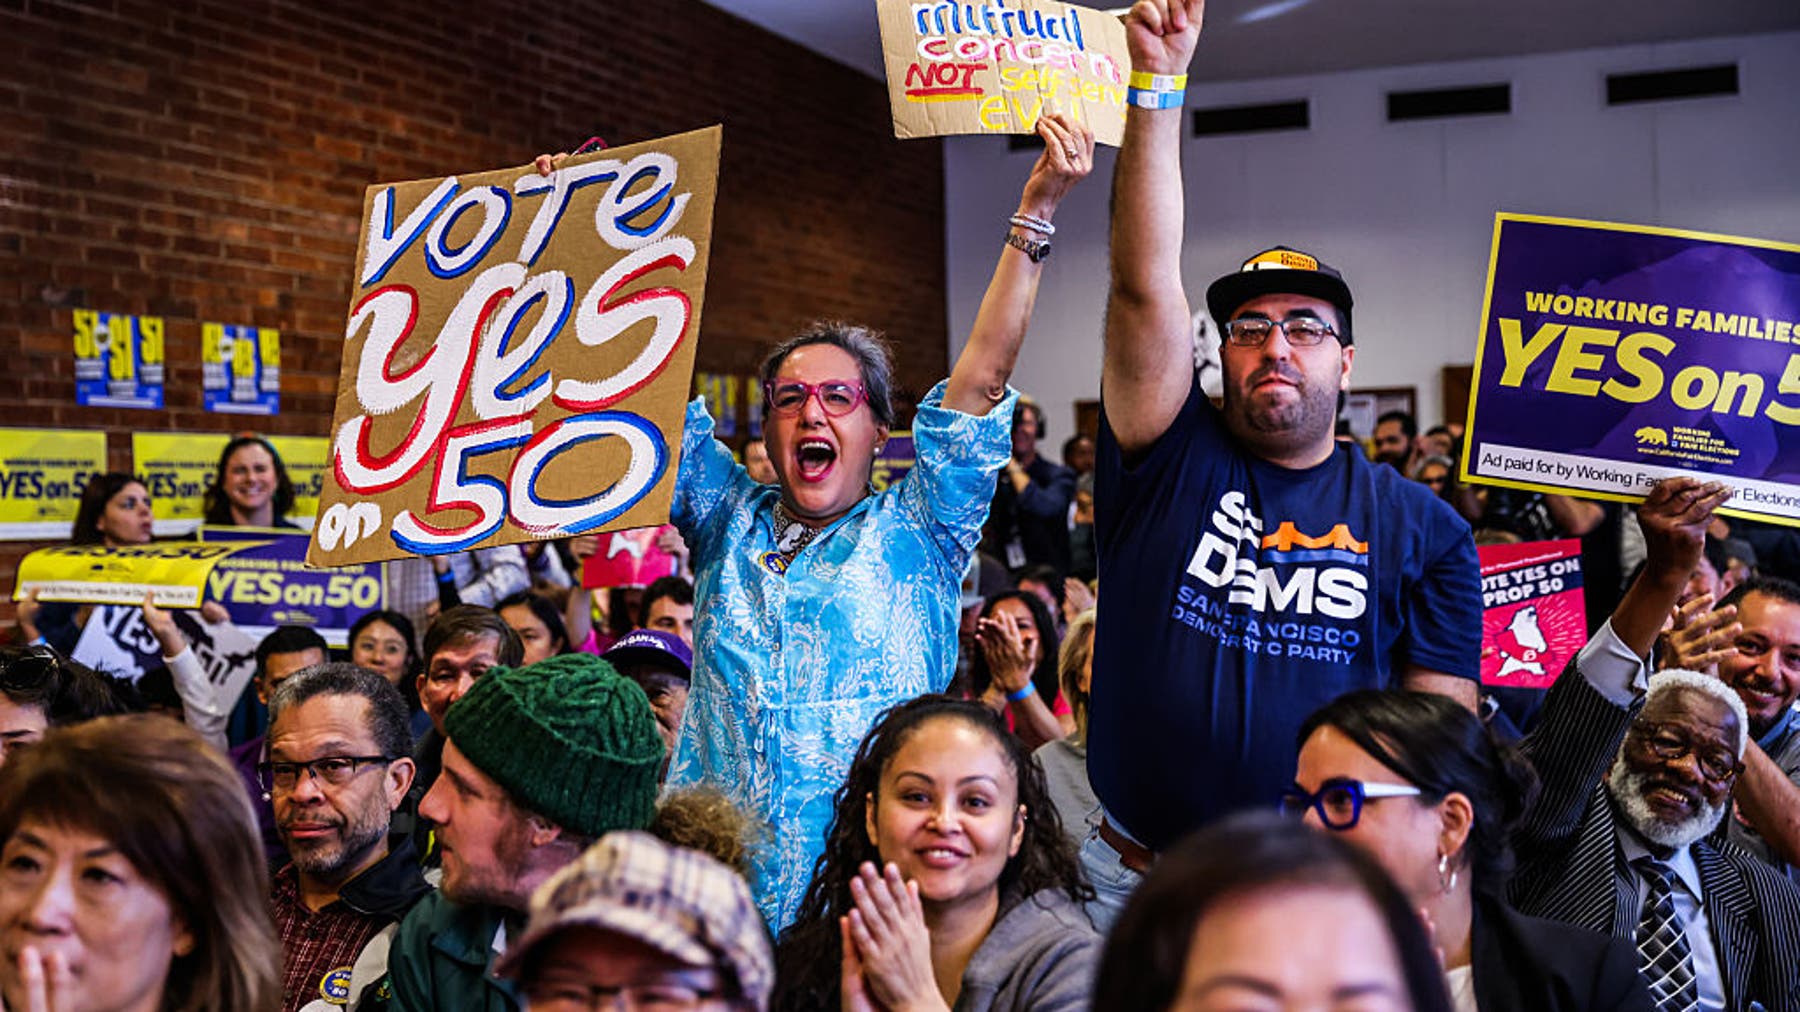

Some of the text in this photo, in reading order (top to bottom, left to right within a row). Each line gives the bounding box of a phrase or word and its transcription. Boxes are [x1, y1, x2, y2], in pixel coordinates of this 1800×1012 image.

[916, 37, 1122, 85] concern
[905, 63, 988, 88] NOT
[1000, 65, 1066, 99] self
[979, 94, 1079, 131] evl
[1525, 291, 1668, 326] WORKING
[1498, 317, 1800, 426] YES on 5
[0, 471, 44, 499] YES
[46, 481, 69, 498] on
[317, 409, 671, 555] on 50
[1481, 453, 1502, 467] Ad
[1505, 456, 1533, 471] paid
[1536, 459, 1554, 473] for
[1556, 462, 1574, 479] by
[1577, 465, 1632, 487] Working
[1186, 531, 1369, 620] DEMS
[1510, 564, 1547, 584] YES
[1549, 557, 1580, 576] ON
[209, 570, 285, 605] YES
[284, 583, 324, 606] on
[325, 575, 380, 609] 50
[1176, 585, 1226, 619] SAN
[1482, 576, 1564, 608] PROP 50
[1171, 605, 1283, 656] DEMORATC
[1287, 644, 1356, 666] PARTY
